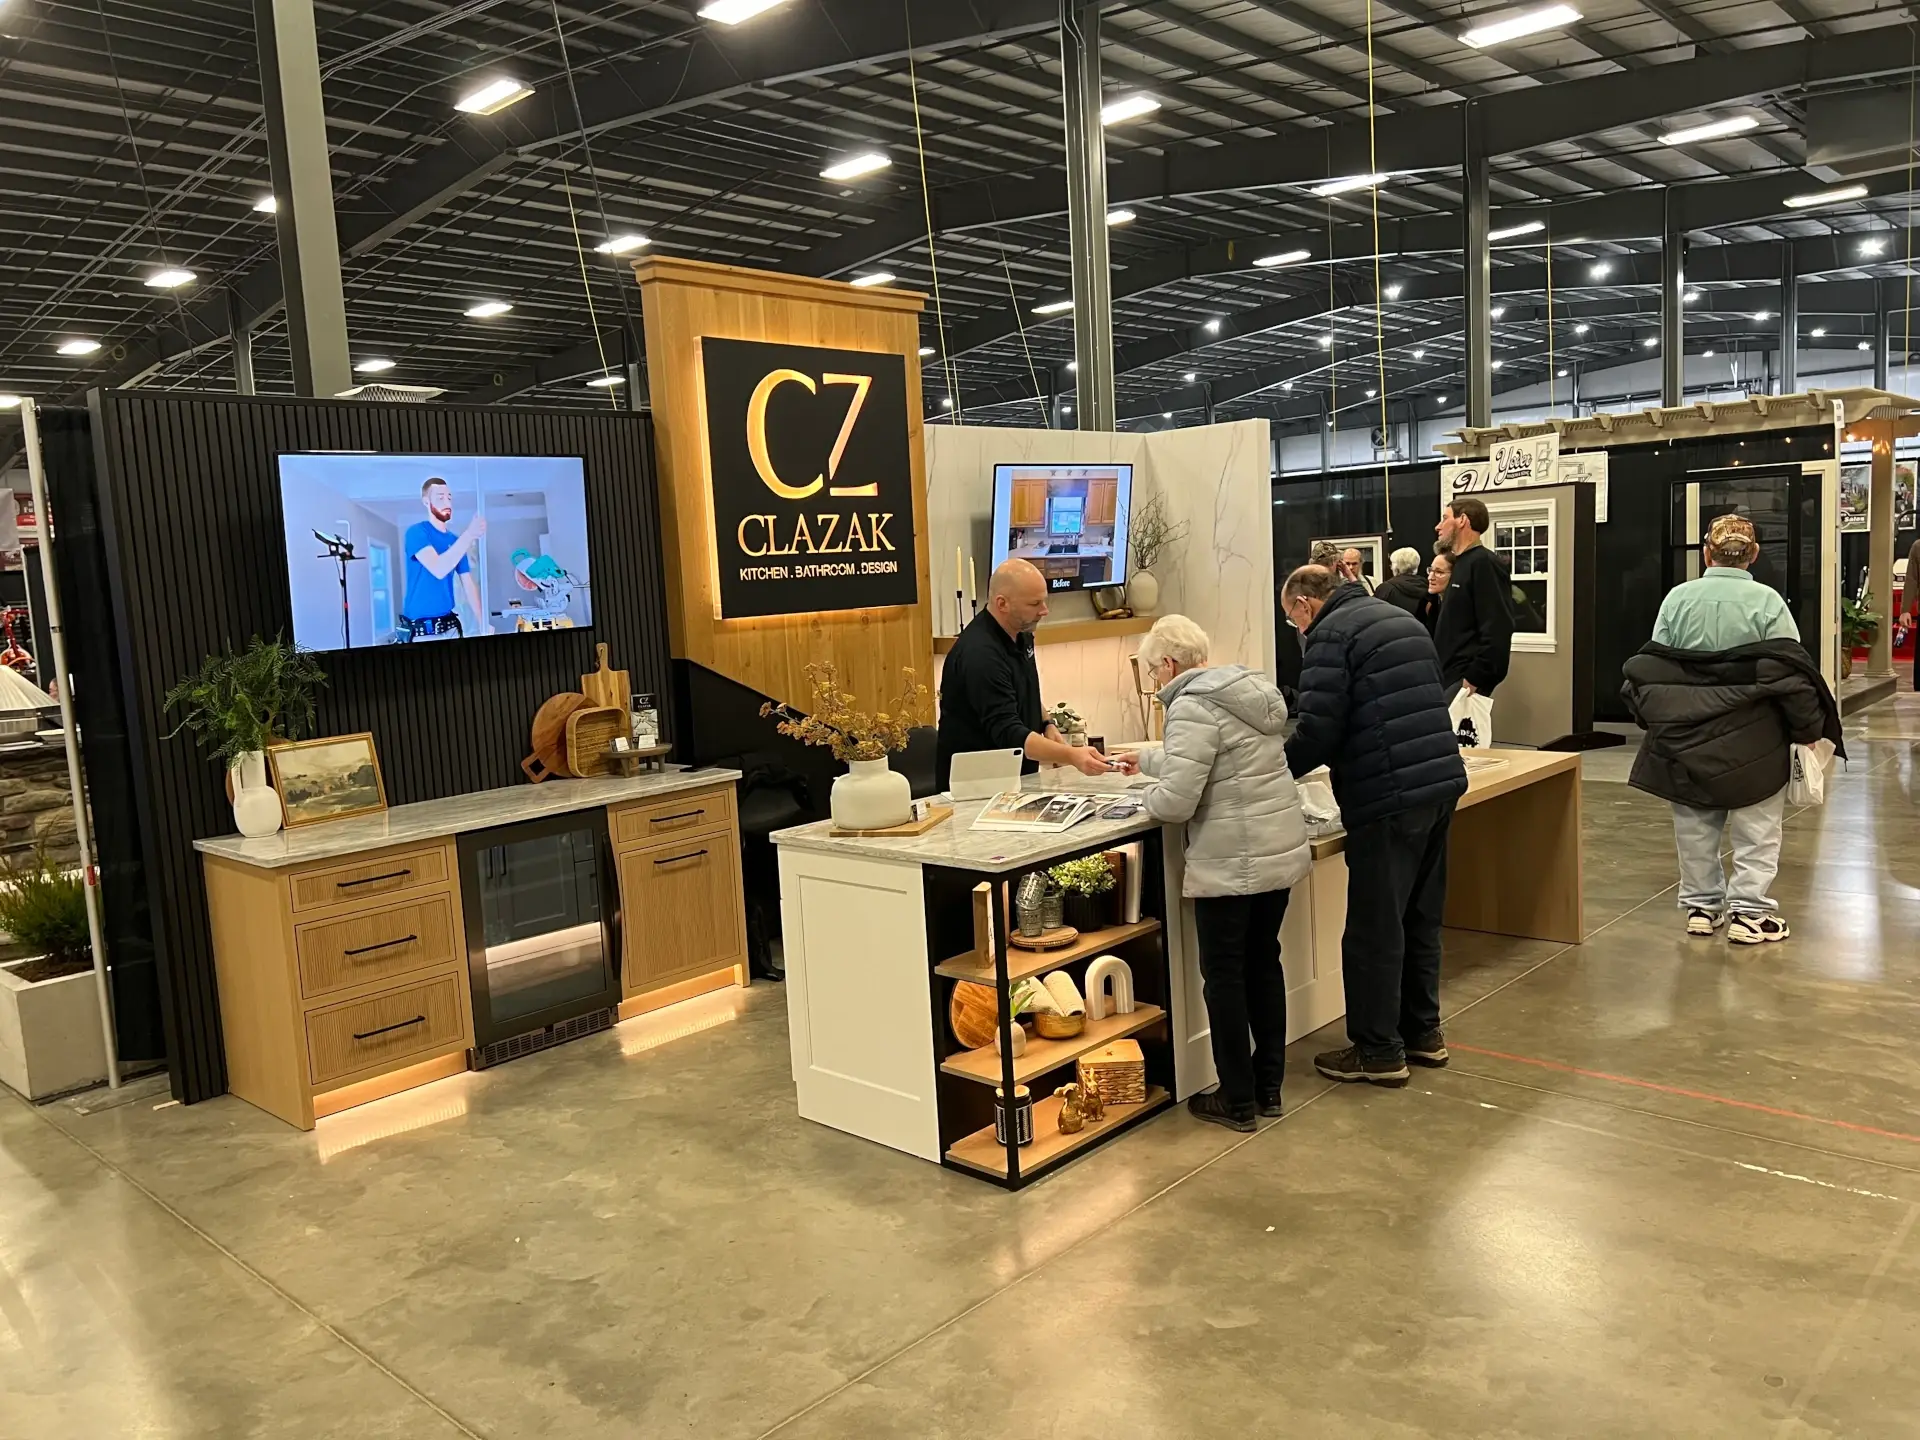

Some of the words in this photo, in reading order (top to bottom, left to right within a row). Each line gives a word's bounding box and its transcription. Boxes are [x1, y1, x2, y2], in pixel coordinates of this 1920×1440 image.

[746, 368, 878, 499] CZ
[1494, 446, 1533, 486] Yoder
[737, 512, 896, 557] CLAZAK
[739, 566, 789, 581] KITCHEN
[795, 562, 855, 578] BATHROOM
[861, 560, 898, 575] DESIGN
[1052, 579, 1070, 588] Before
